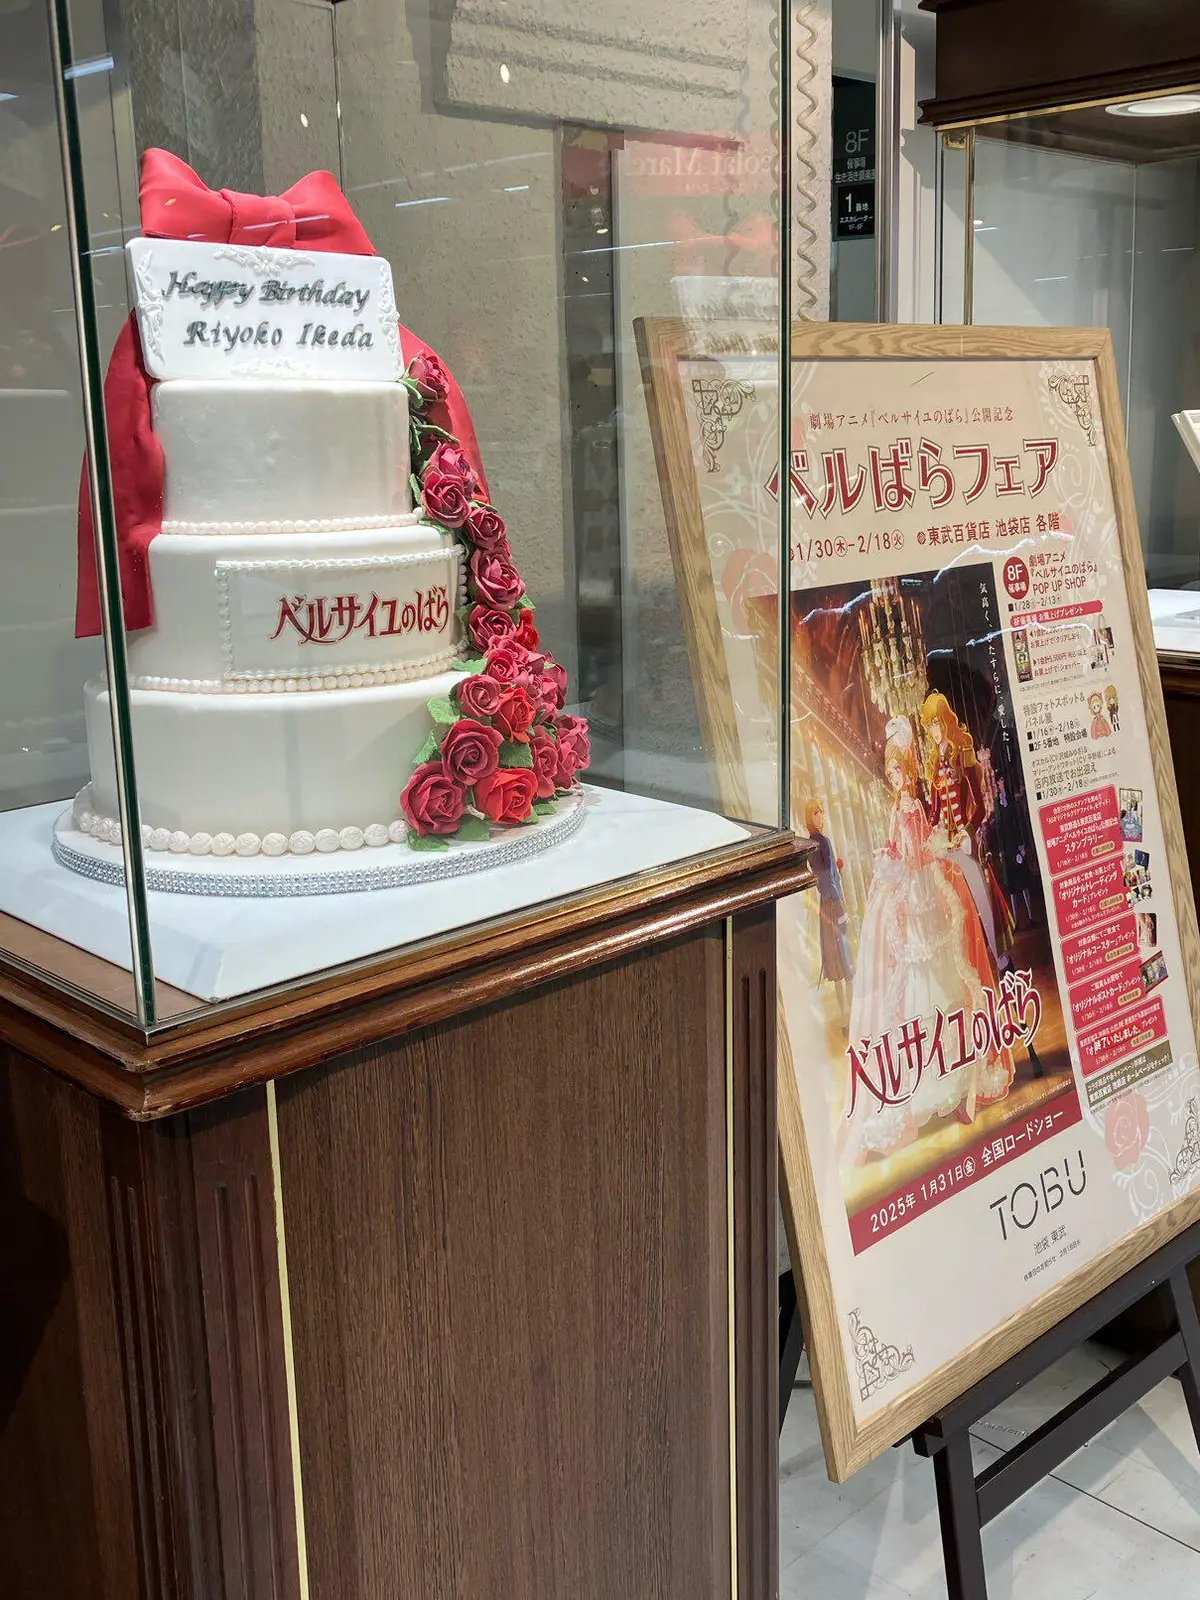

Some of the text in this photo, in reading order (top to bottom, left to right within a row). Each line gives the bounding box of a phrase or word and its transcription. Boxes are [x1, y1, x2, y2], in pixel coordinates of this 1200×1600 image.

[845, 129, 869, 153] 8F
[162, 271, 371, 313] Happy Birthday
[183, 320, 374, 352] Riyoko Ikeda
[764, 437, 1059, 520] ベルばらフェア
[1007, 564, 1023, 581] 8F
[1033, 577, 1086, 595] POP UP SHOP
[269, 585, 450, 646] ベルサイユのばら
[1065, 834, 1104, 854] スタンプラリー
[846, 967, 1042, 1119] ベルサイユのばら
[870, 1193, 916, 1233] 2025年
[981, 1111, 1064, 1167] 全国ロードショー
[989, 1150, 1086, 1241] TOBU
